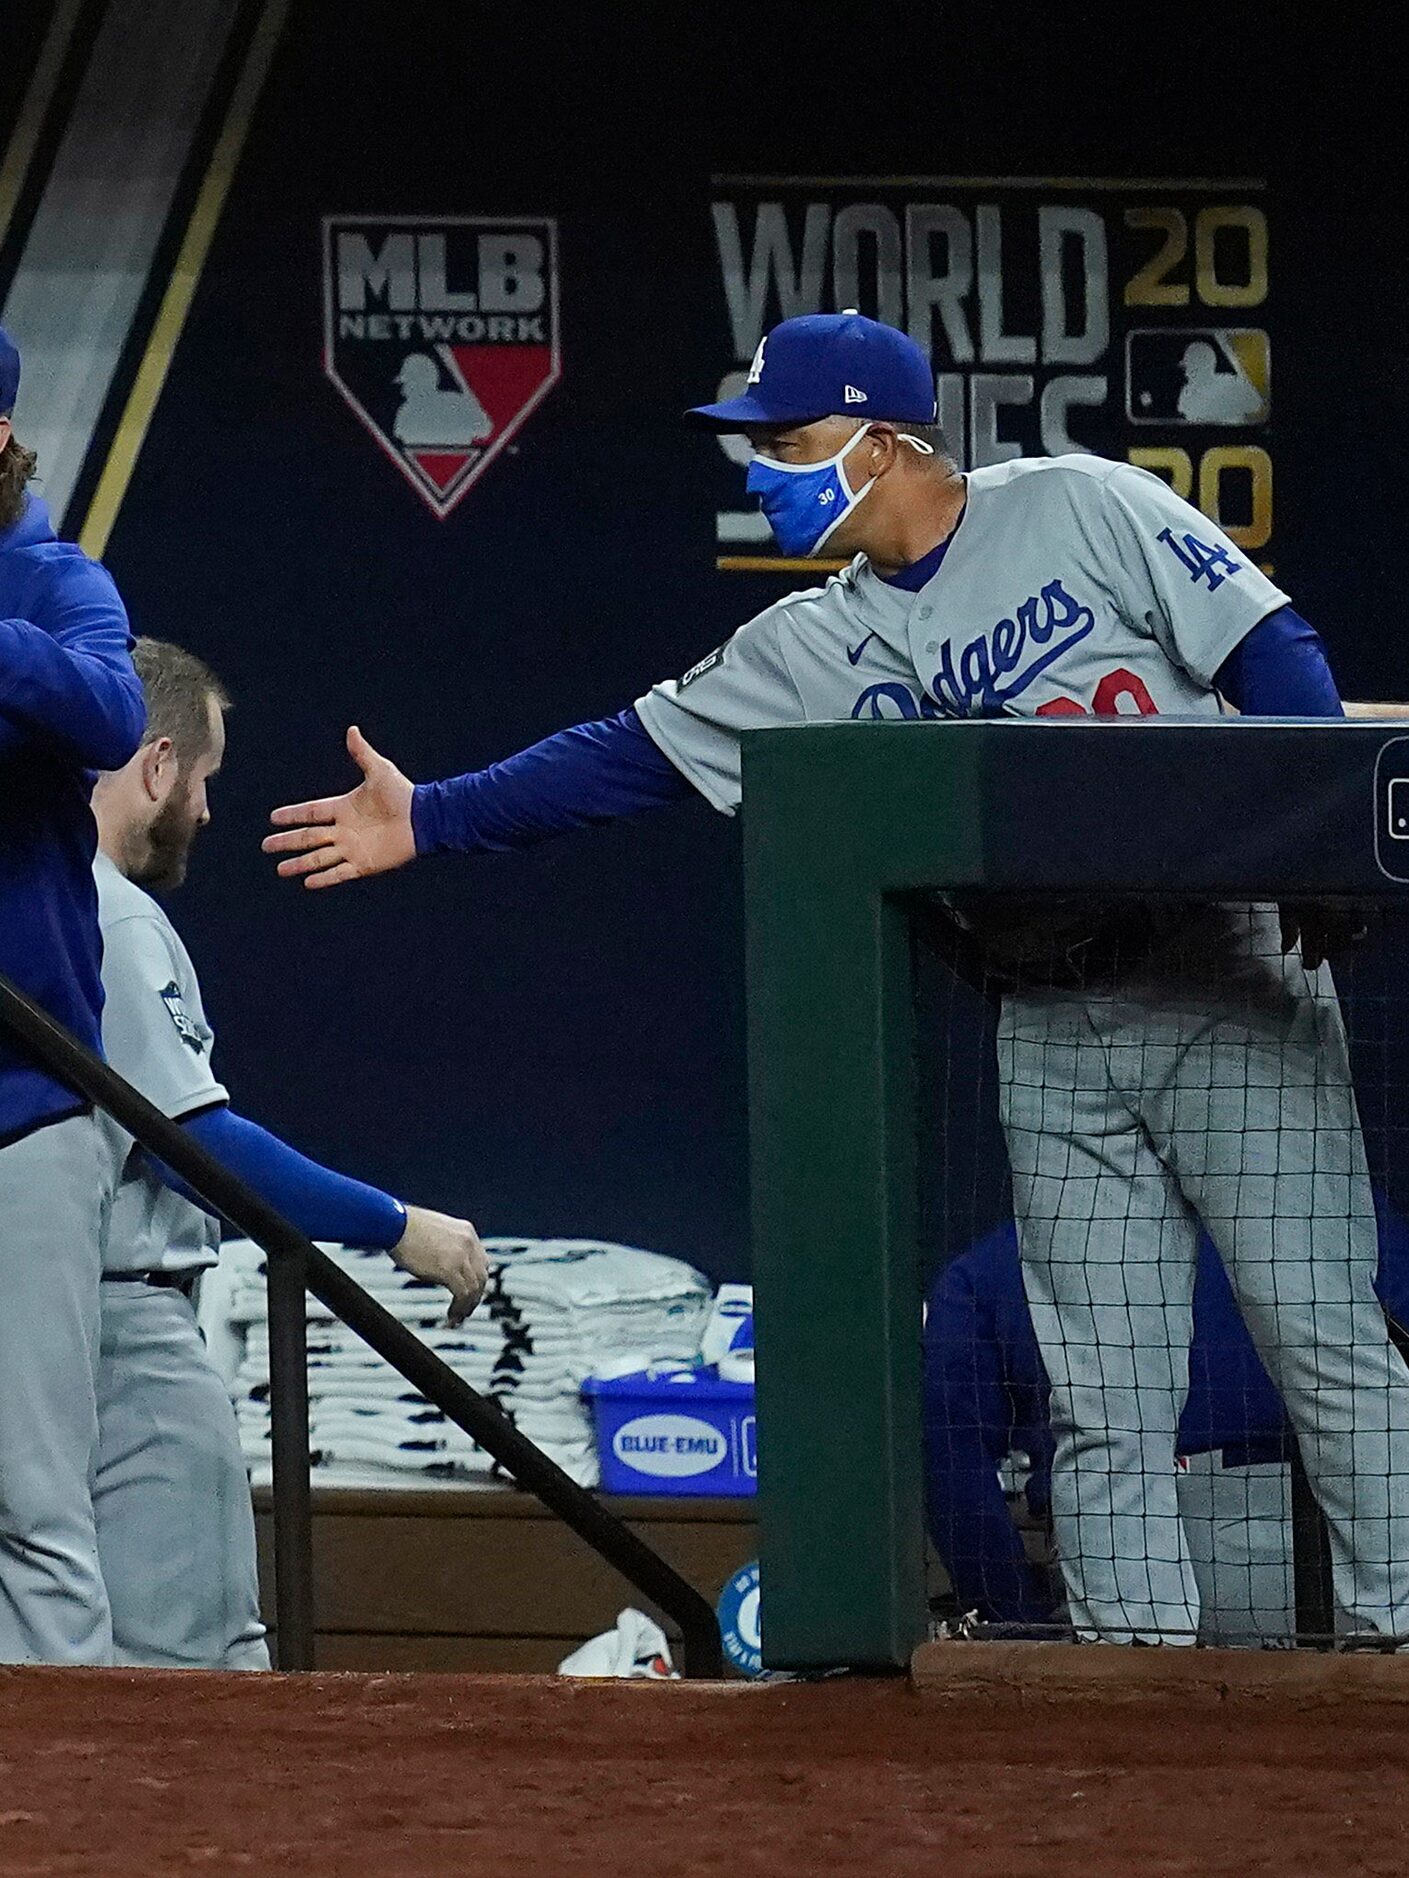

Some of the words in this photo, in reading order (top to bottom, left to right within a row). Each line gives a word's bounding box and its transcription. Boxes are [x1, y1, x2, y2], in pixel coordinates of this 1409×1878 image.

[336, 232, 547, 313] MLB
[711, 201, 1110, 366] WORLD
[1124, 205, 1269, 308] 20
[338, 313, 547, 342] NETWORK
[817, 488, 836, 506] 30
[1155, 526, 1244, 593] LA
